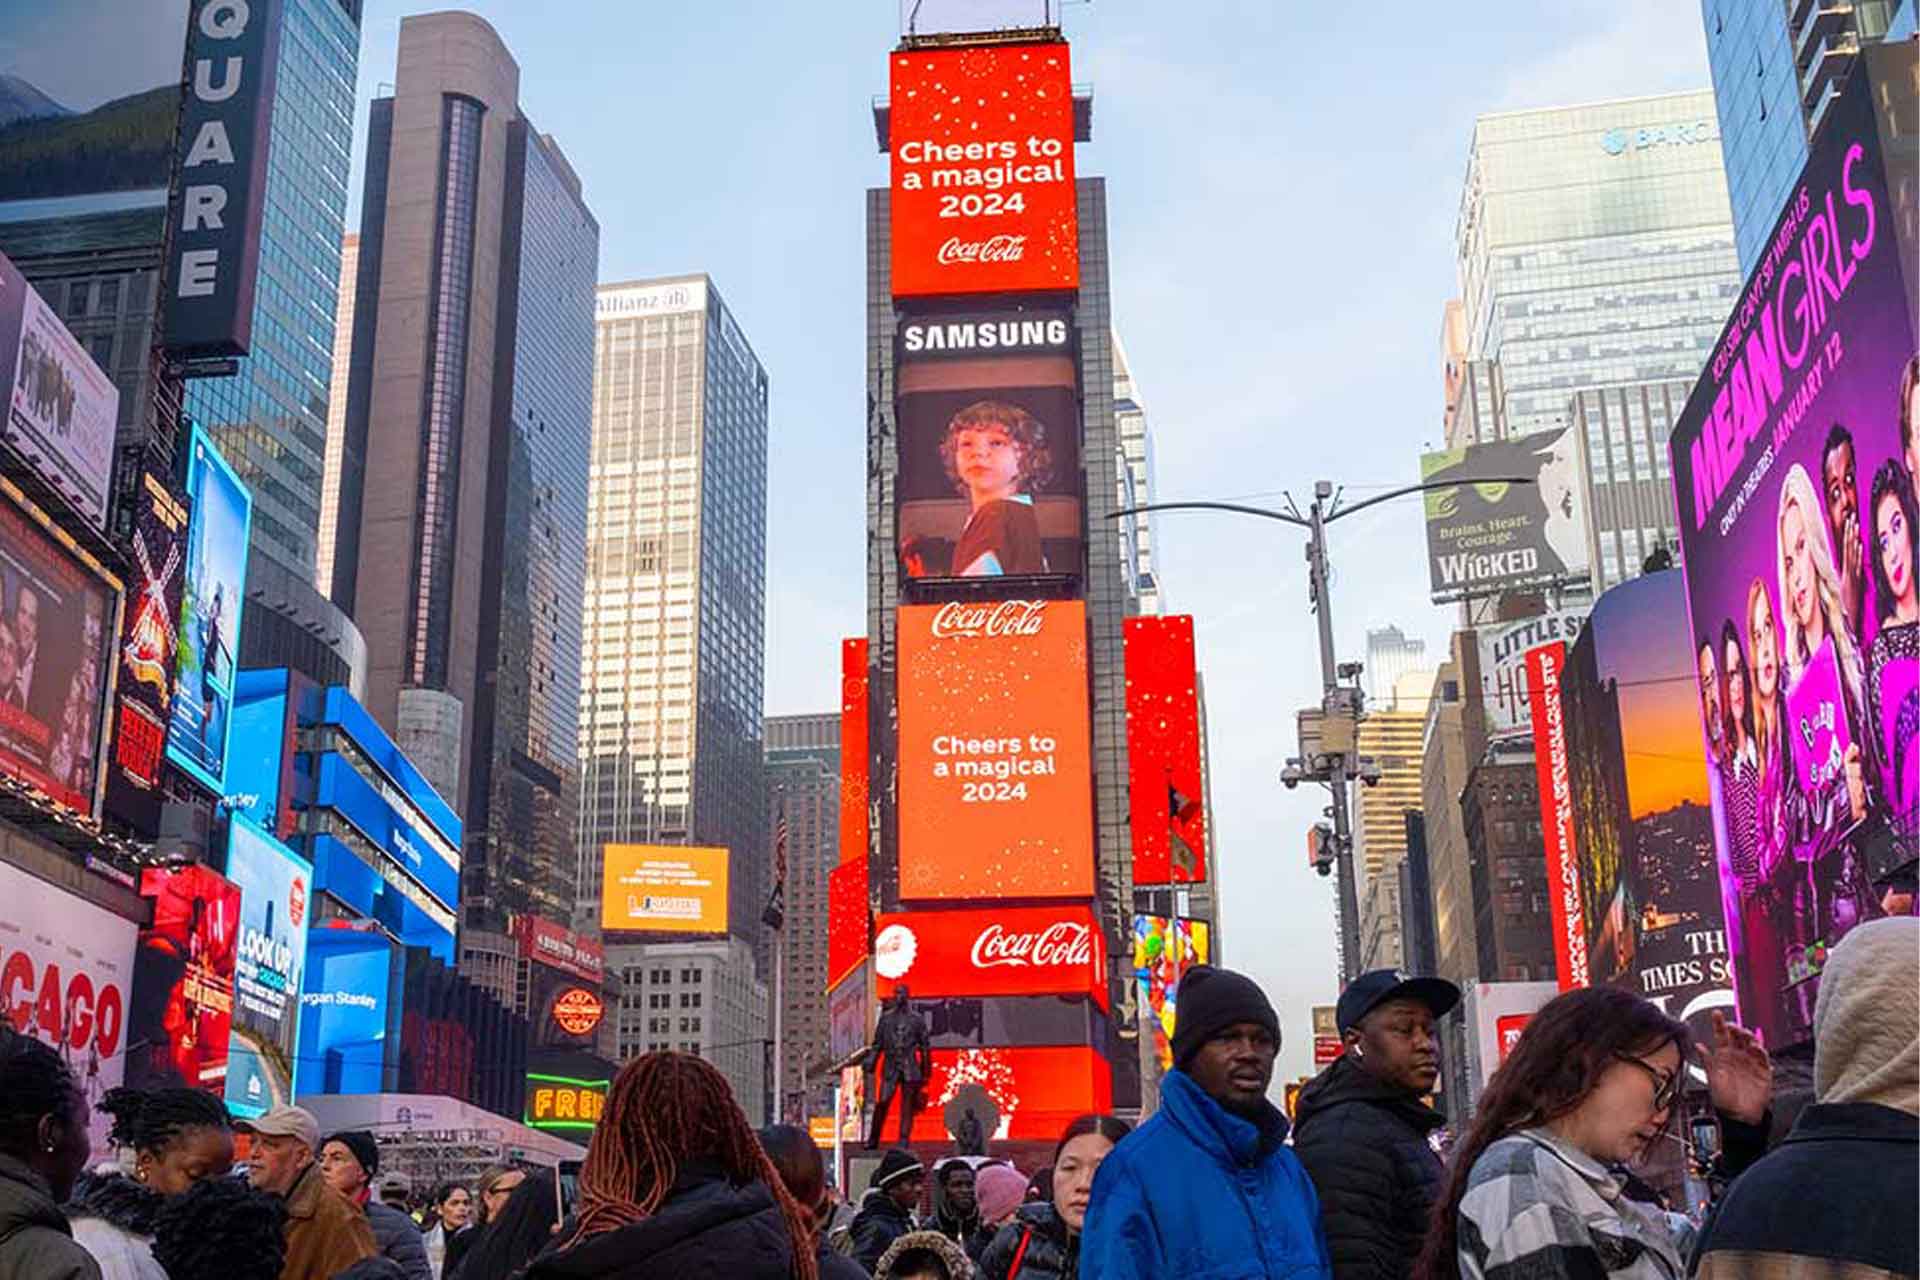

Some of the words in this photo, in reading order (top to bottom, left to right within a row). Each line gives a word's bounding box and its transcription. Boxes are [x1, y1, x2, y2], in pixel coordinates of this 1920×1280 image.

[900, 141, 1017, 163] Cheers
[1027, 136, 1062, 157] to
[902, 172, 923, 190] a
[932, 160, 1065, 189] magical
[939, 192, 1026, 218] 2024
[905, 320, 1067, 351] SAMSUNG
[1691, 302, 1784, 531] MEAN
[1776, 143, 1876, 370] GIRLS
[1773, 357, 1824, 456] JANUARY
[1825, 332, 1843, 370] 12
[1494, 618, 1561, 664] LITTLE
[931, 736, 1021, 756] Cheers
[1029, 735, 1056, 752] to
[933, 762, 949, 777] a
[954, 756, 1055, 777] magical
[961, 783, 1028, 802] 2024
[239, 923, 275, 969] LOOK
[1641, 961, 1703, 992] TIMES
[1, 951, 122, 1059] CAGO
